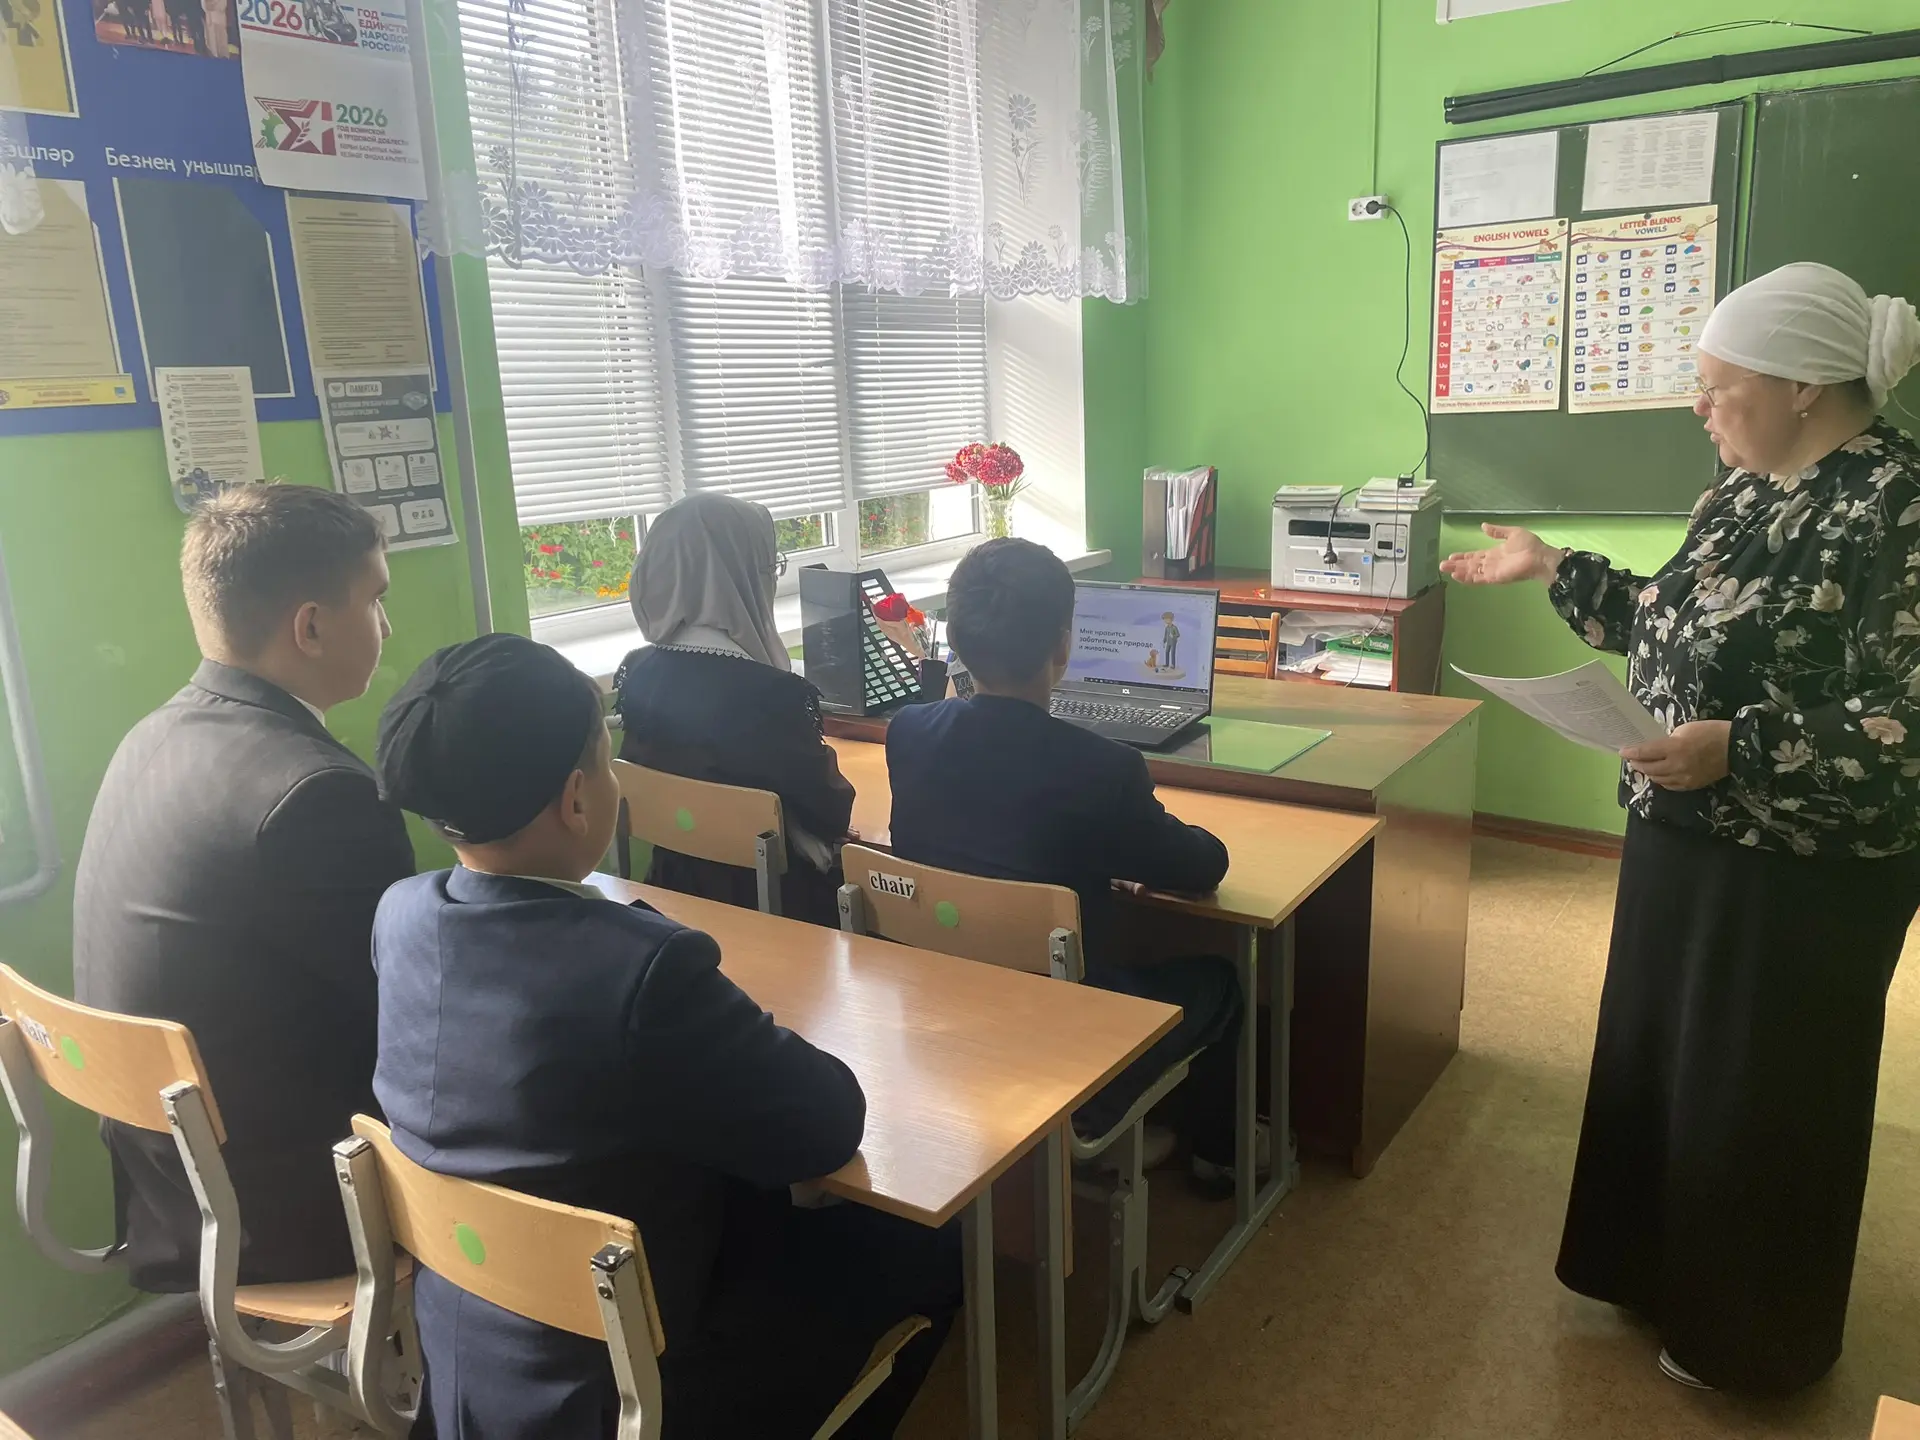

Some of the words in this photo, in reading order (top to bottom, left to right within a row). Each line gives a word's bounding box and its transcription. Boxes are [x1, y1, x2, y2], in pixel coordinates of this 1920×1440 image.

[239, 0, 303, 31] 2026
[357, 8, 379, 20] ГОД
[358, 19, 409, 34] ЕДИНСТВ
[362, 40, 406, 54] РОССИИ
[335, 103, 389, 128] 2026
[1619, 218, 1648, 230] LETTER
[1649, 215, 1682, 227] BLENDS
[1634, 225, 1668, 235] VOWELS
[1473, 231, 1510, 243] ENGLISH
[1512, 228, 1549, 239] VOWELS
[1079, 636, 1117, 645] заботиться
[1123, 640, 1154, 648] природе
[870, 872, 914, 897] chair
